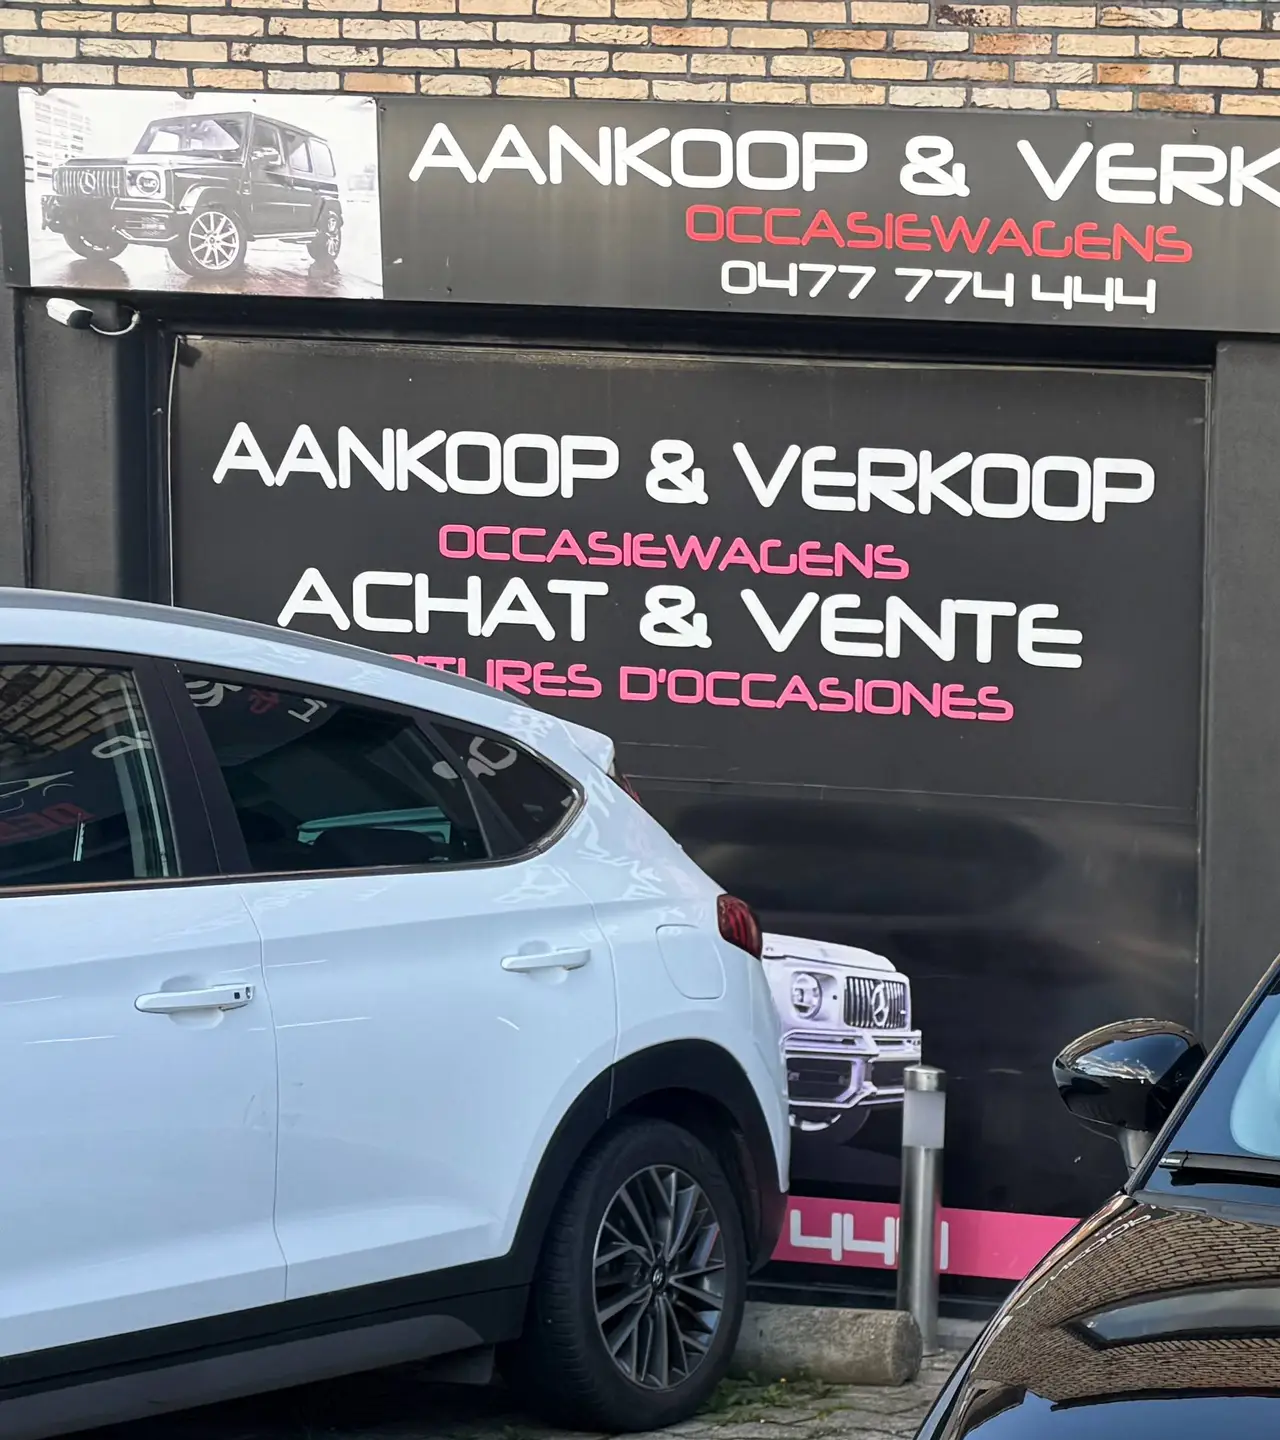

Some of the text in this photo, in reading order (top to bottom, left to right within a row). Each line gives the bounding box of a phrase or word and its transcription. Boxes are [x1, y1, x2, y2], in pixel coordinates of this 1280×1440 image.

[408, 122, 868, 192] AANKOOP
[899, 134, 971, 198] &
[686, 204, 1193, 264] OCCASIEWAGENS
[720, 259, 1157, 314] 0477 774 444
[212, 421, 1155, 523] AANKOOP & VERKOOP
[438, 524, 910, 580] OCCASIEWAGENS
[277, 567, 1083, 669] ACHAT & VENTE
[619, 666, 1015, 722] D'OCCASIONES
